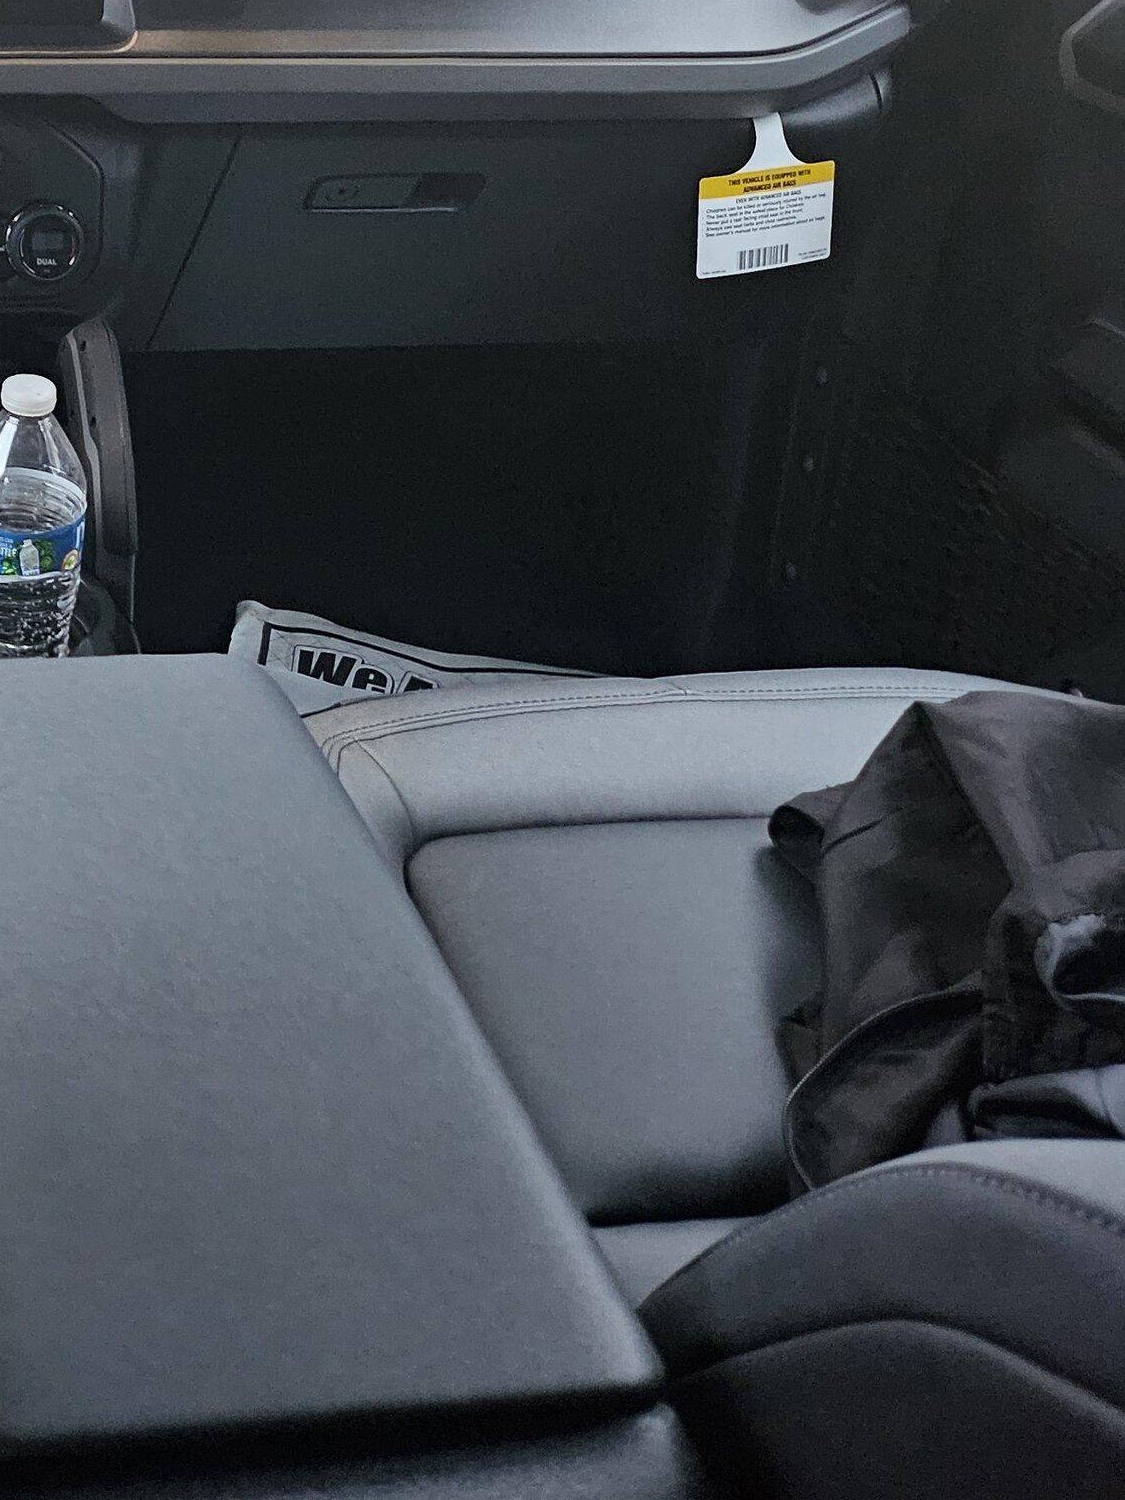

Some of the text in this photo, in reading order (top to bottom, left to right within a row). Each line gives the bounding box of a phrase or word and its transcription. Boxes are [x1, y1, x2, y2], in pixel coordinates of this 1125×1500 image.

[742, 175, 763, 184] VEHICLE
[772, 171, 796, 180] EQUIPPED
[743, 183, 771, 193] ADVANCED
[783, 180, 796, 188] BAGS
[36, 257, 57, 266] DUAL
[297, 649, 389, 695] We
